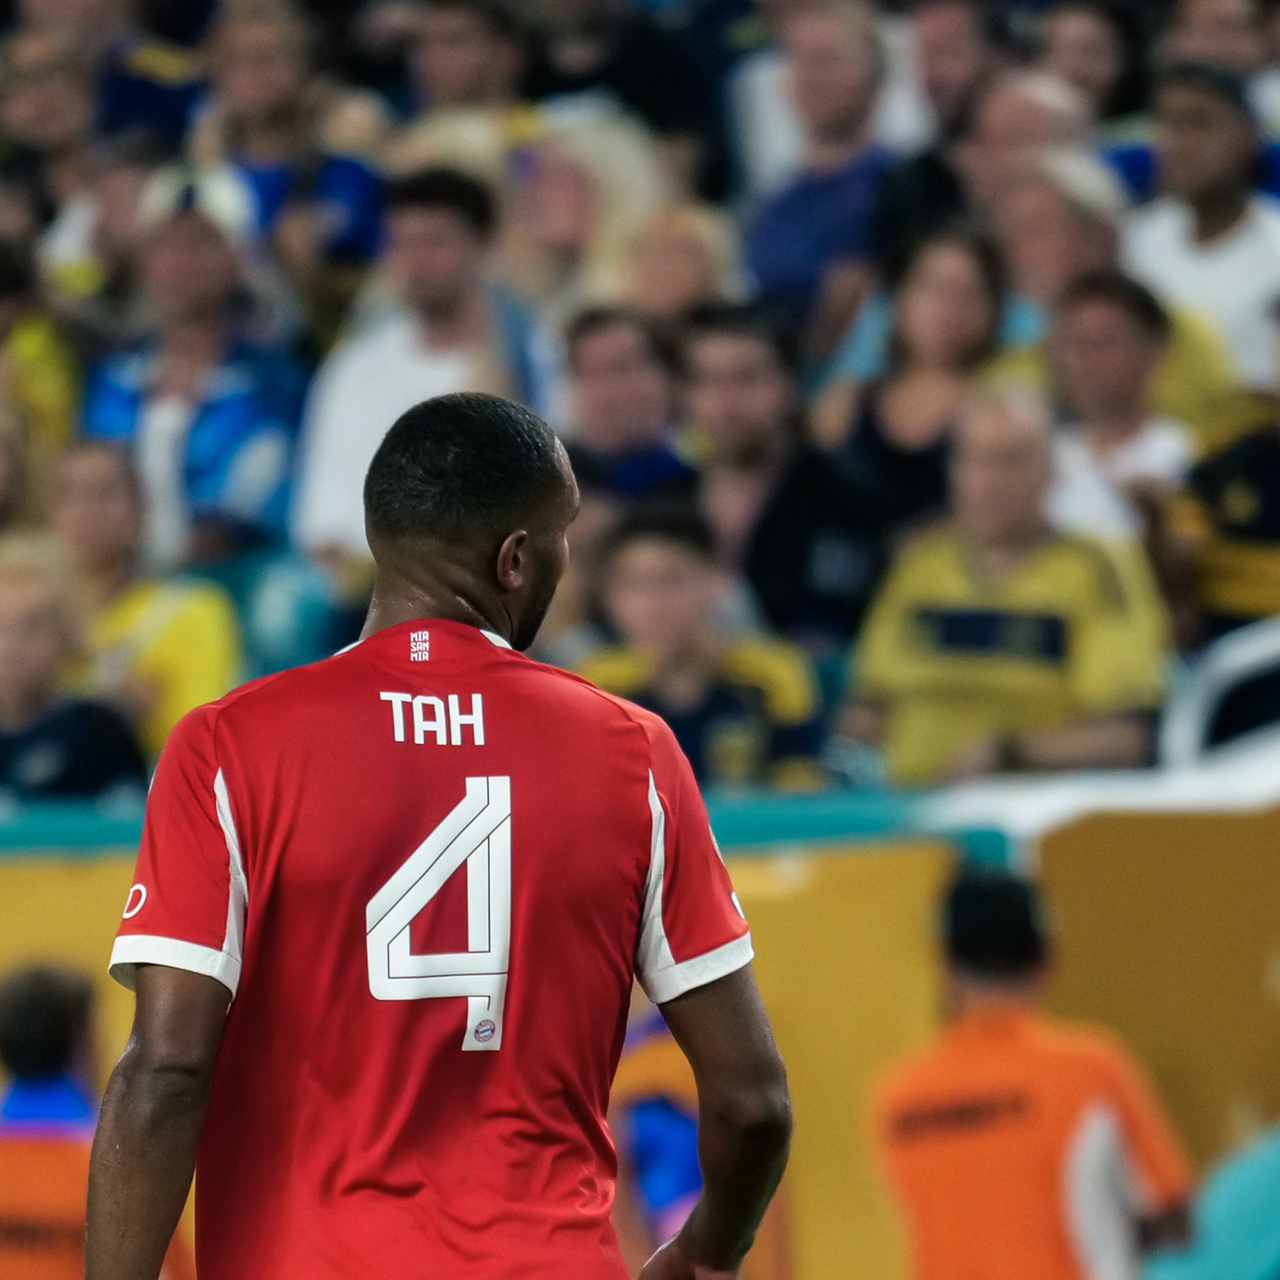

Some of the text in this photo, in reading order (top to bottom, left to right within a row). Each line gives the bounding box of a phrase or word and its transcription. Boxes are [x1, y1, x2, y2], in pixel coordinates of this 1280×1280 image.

[410, 630, 430, 642] MIA
[410, 641, 430, 652] SAN
[410, 651, 430, 662] MIA
[380, 691, 485, 746] TAH
[365, 775, 512, 1051] 4
